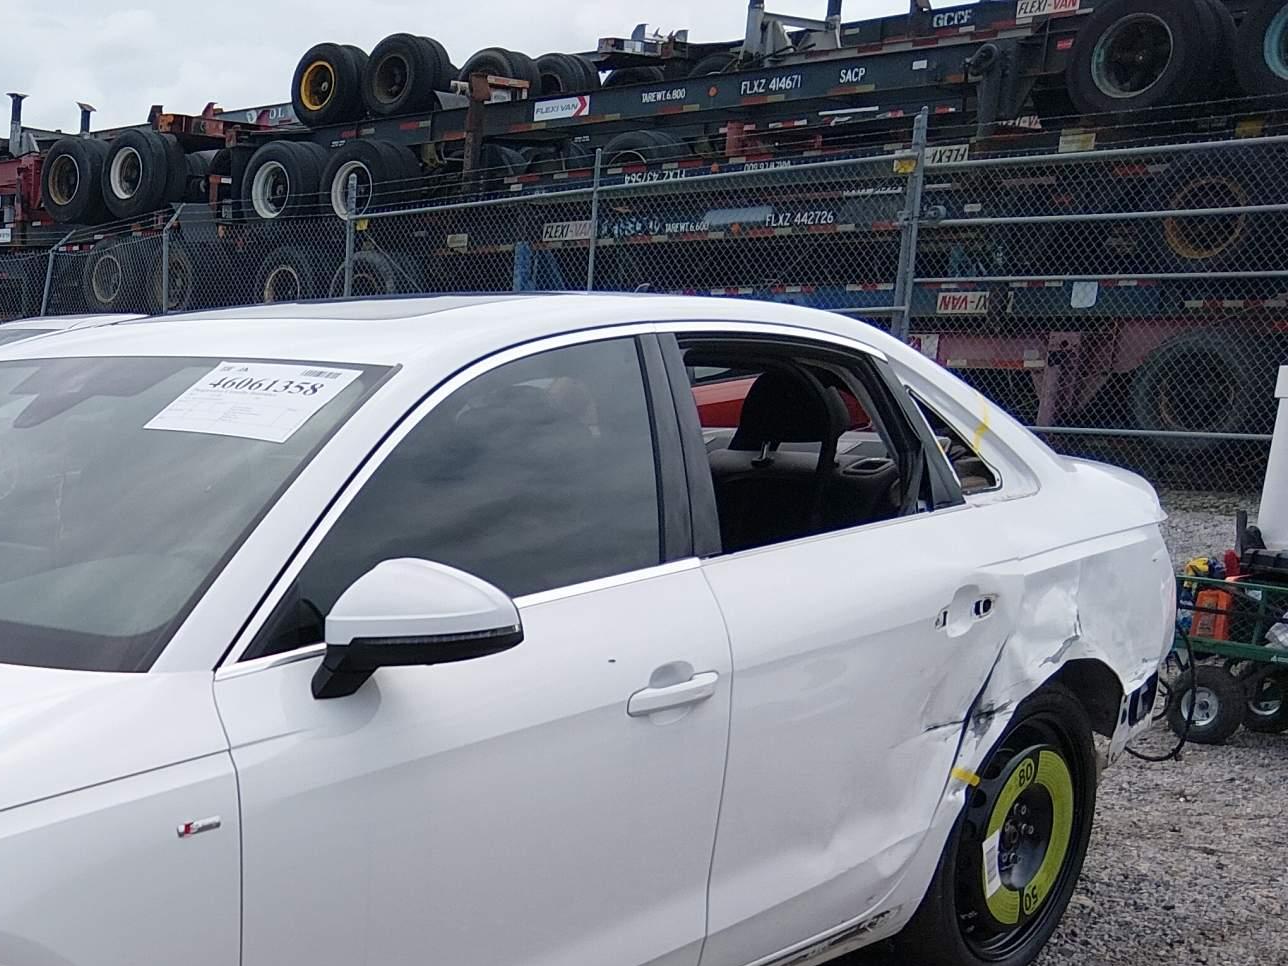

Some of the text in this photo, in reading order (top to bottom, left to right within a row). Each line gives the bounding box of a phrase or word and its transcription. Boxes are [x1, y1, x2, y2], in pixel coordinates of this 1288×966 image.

[740, 74, 802, 95] FLXZ 414671
[839, 67, 866, 84] SACP
[536, 102, 579, 115] FLEXI VAN
[765, 210, 834, 227] FLXZ 442726
[208, 376, 325, 396] 46061358
[1018, 763, 1033, 787] 80
